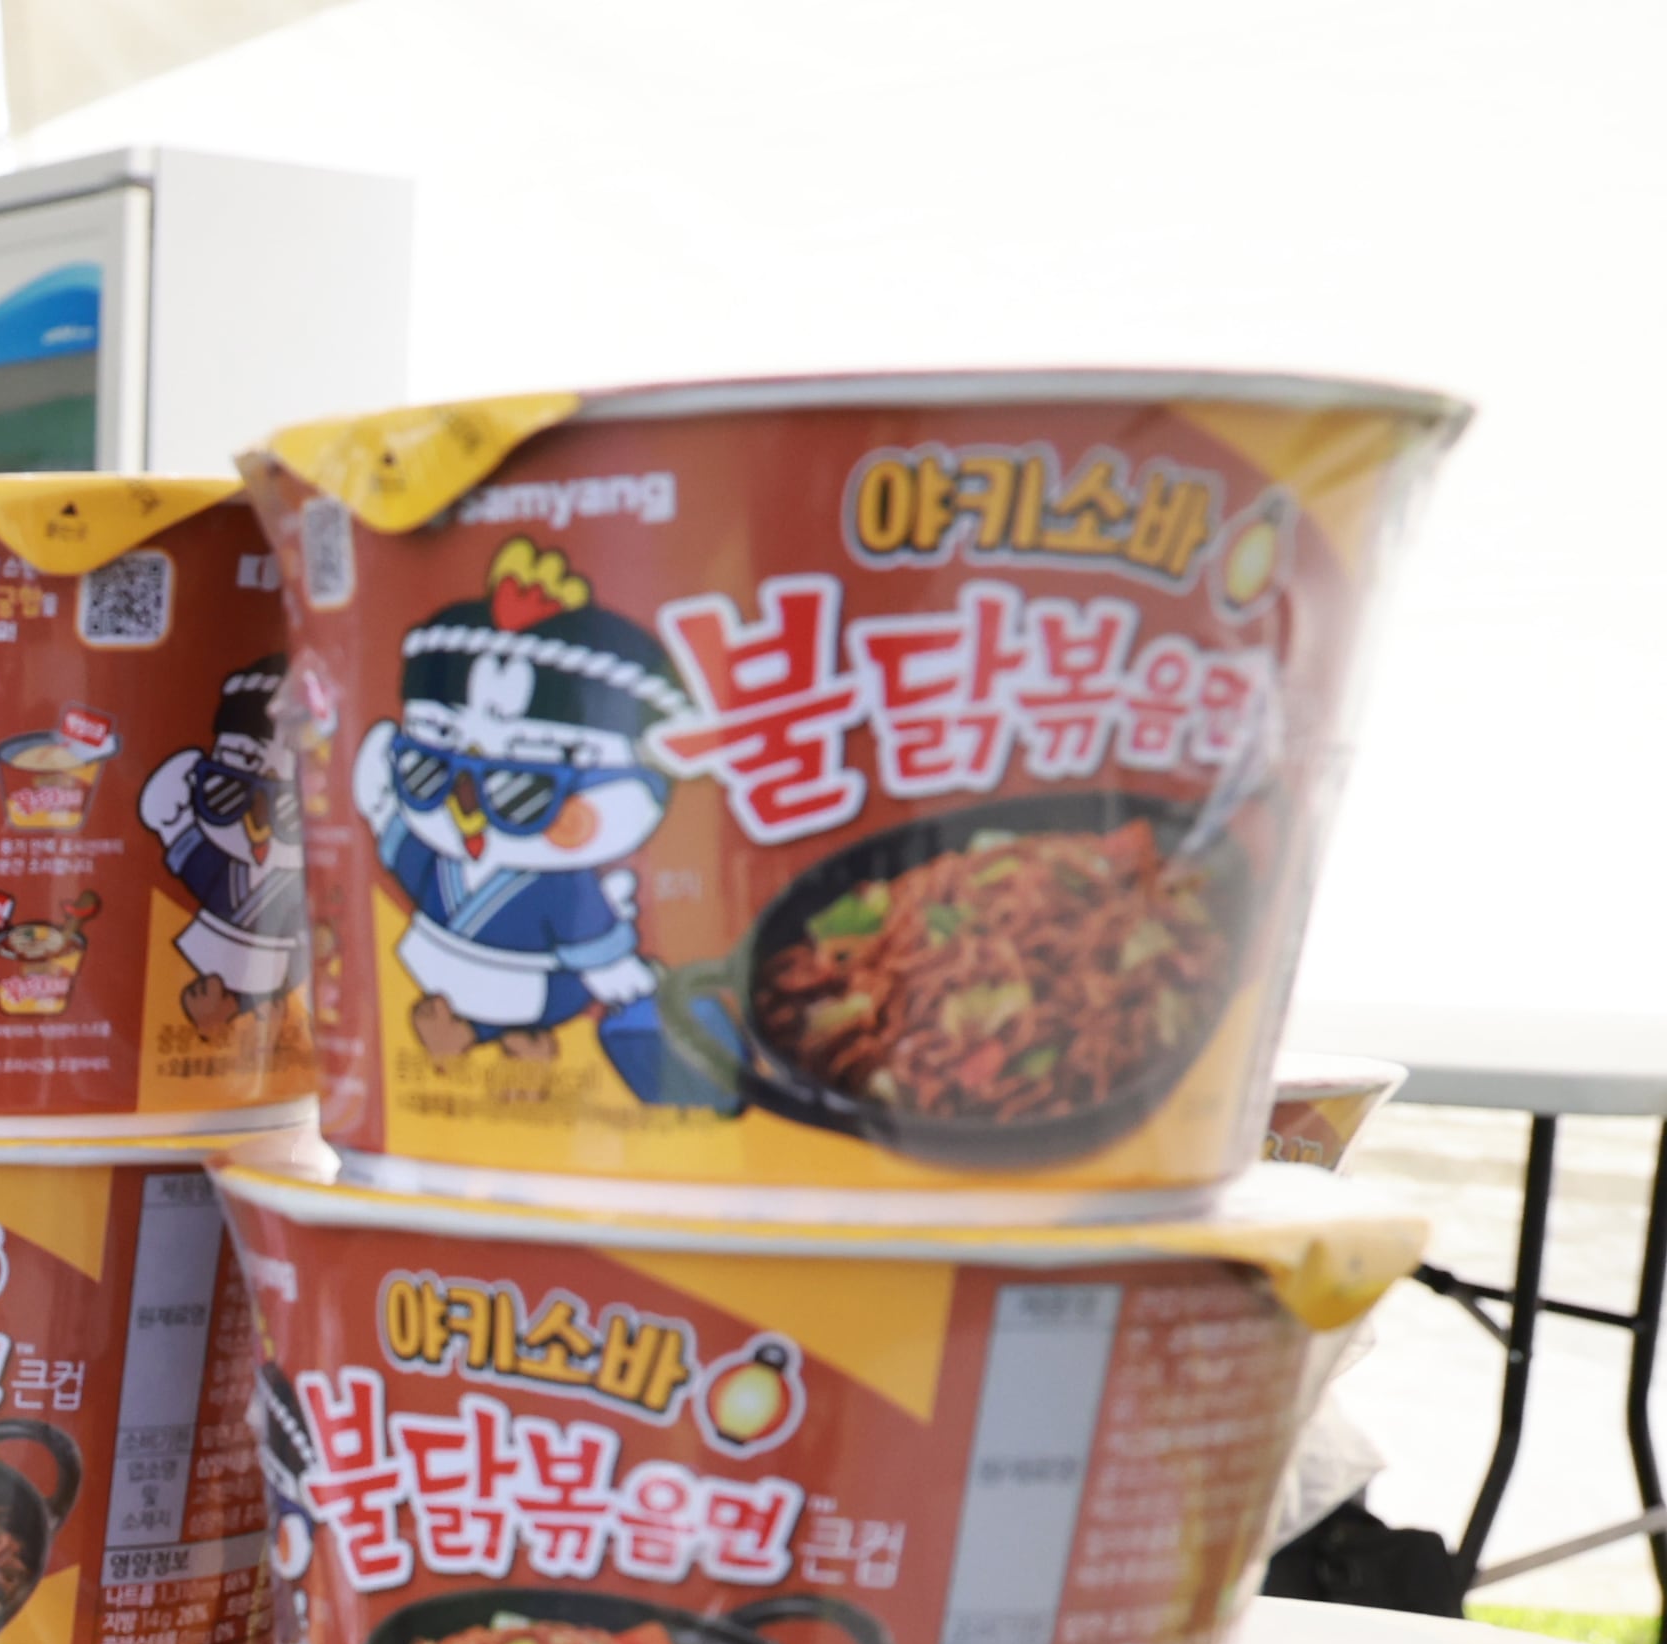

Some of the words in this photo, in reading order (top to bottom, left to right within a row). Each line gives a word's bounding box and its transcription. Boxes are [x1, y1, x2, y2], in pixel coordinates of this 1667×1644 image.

[847, 445, 1222, 593] 야키소바
[646, 574, 1282, 848] 불닭볶음면
[11, 1359, 87, 1411] 큰컵
[376, 1267, 697, 1421] 야키소바
[297, 1367, 807, 1598] 불닭볶음면
[799, 1495, 907, 1587] 큰컵
[110, 1550, 190, 1580] 영양정보
